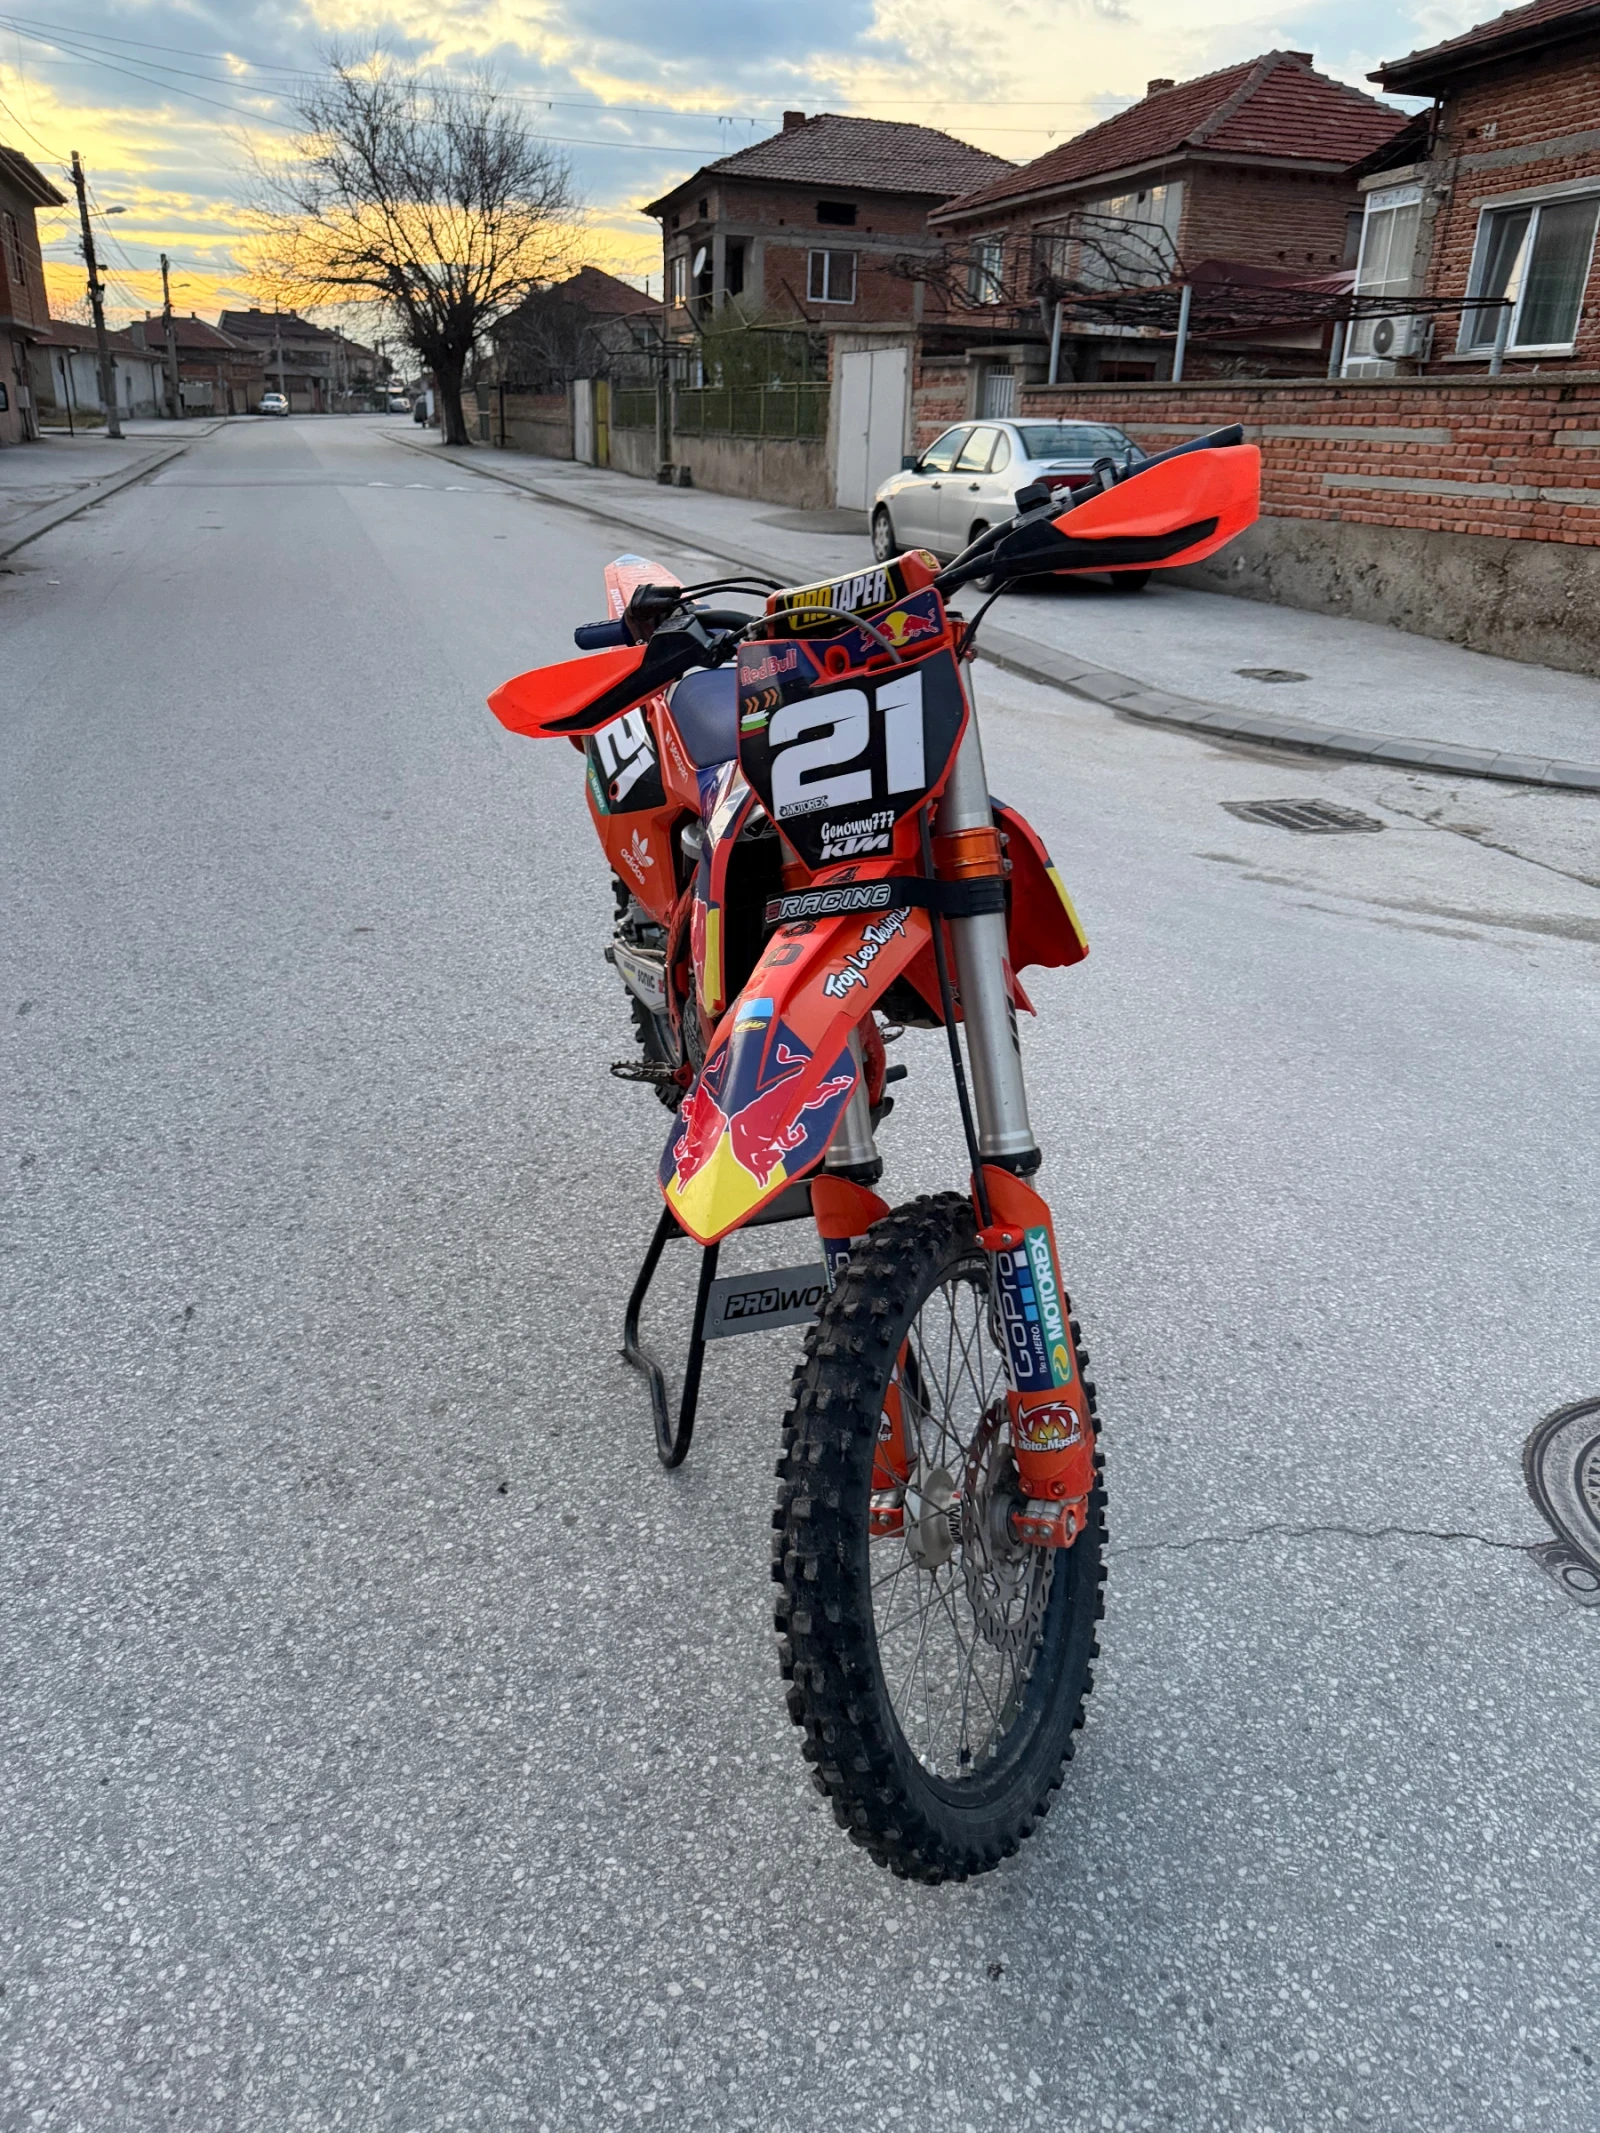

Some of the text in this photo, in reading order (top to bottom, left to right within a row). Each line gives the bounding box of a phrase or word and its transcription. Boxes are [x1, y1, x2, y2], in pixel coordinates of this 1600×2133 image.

[768, 671, 926, 820] 21
[785, 795, 829, 816] MOTOREX
[820, 834, 890, 860] KTM
[620, 848, 646, 885] adidas
[845, 943, 879, 969] Lee
[824, 966, 868, 998] Troy
[1029, 1232, 1064, 1341] MOTOREX
[998, 1252, 1034, 1378] GoPro
